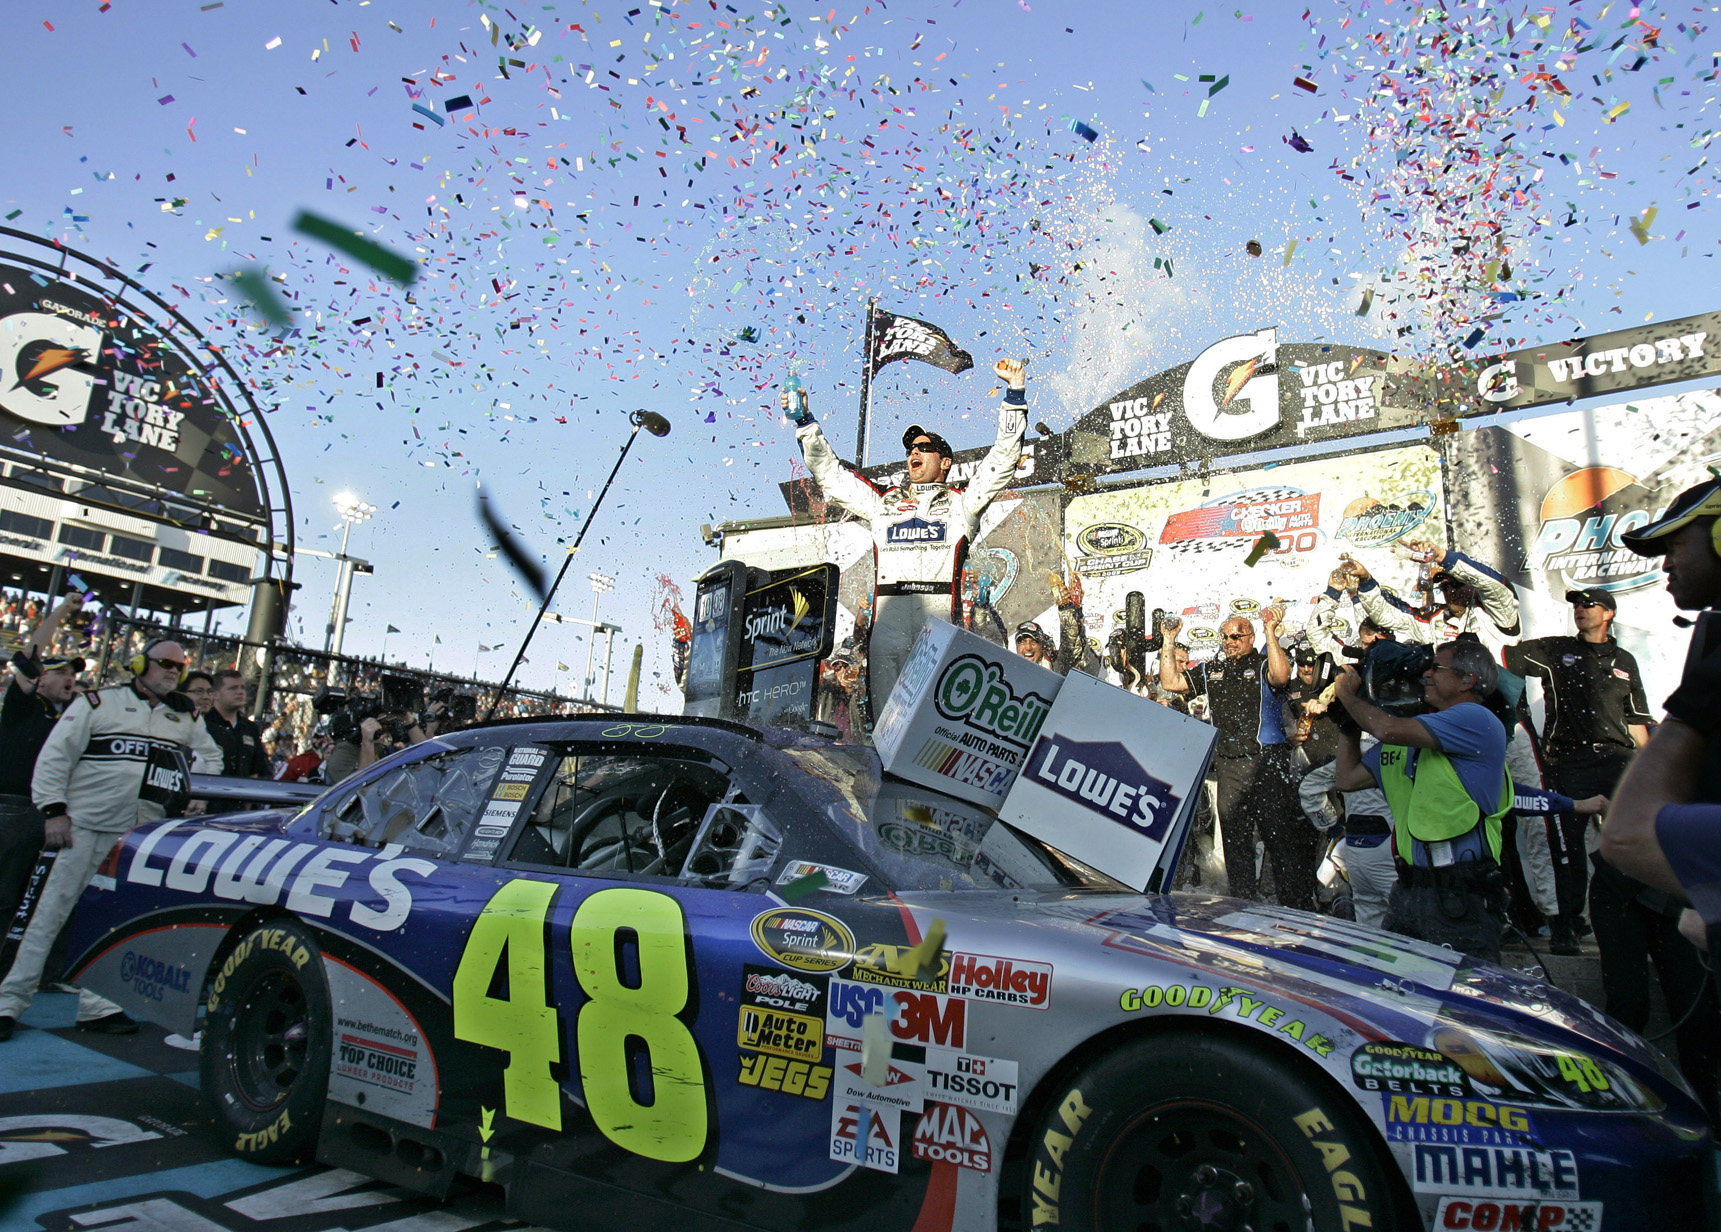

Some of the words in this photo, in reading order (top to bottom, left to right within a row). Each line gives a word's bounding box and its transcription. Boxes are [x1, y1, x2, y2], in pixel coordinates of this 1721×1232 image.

[1547, 332, 1707, 383] VICTORY
[112, 369, 162, 402] VIC
[1182, 326, 1280, 441] G
[1299, 361, 1345, 387] VIC
[1300, 377, 1375, 405] TORY
[107, 390, 185, 431] TORY
[1109, 397, 1149, 421] VIC
[1302, 393, 1375, 429] LANE
[100, 411, 181, 453] LANE
[1109, 413, 1172, 440] TORY
[1109, 431, 1172, 460] LANE
[1230, 500, 1302, 521] CHECKER
[1335, 509, 1425, 540] PHOENIX
[892, 526, 941, 540] LOWE'S
[1572, 558, 1659, 581] RACEWAY
[744, 603, 788, 645] Sprint
[940, 661, 1050, 743] O'Reill
[934, 726, 960, 741] Official
[959, 732, 987, 752] AUTO
[509, 754, 545, 767] GUARD
[146, 763, 183, 792] LOWE'S
[501, 771, 535, 782] Purolator
[1038, 743, 1161, 828] LOWE'S
[484, 810, 516, 818] SIEMENS
[126, 818, 438, 932] LOWE'S
[780, 919, 820, 933] NASCAR
[782, 932, 818, 948] Sprint
[137, 955, 191, 993] KOBALT
[207, 928, 310, 1014] GOODYEAR
[783, 954, 803, 962] CUP
[804, 957, 838, 967] SERIES
[133, 977, 165, 1002] TOOLS
[746, 974, 781, 996] Coors
[781, 985, 821, 1002] LIGHT
[852, 966, 911, 989] MECHANIX
[912, 980, 947, 993] WEAR
[951, 954, 1049, 1004] Holley
[755, 995, 809, 1012] POLE
[950, 985, 971, 995] HP
[974, 987, 1029, 1004] CARBS
[338, 1018, 418, 1047] www.bethematch.org
[452, 878, 707, 1163] 48
[762, 1014, 808, 1035] Auto
[889, 991, 966, 1049] 3M
[1119, 984, 1336, 1059] GOODYEAR
[757, 1029, 817, 1053] Meter
[761, 1044, 794, 1056] PERFORMANCE
[826, 1036, 863, 1050] SHEETR
[1364, 1045, 1443, 1061] GOODYEAR
[337, 1063, 368, 1079] LUMBER
[371, 1072, 415, 1091] PRODUCTS
[340, 1045, 365, 1065] TOP
[367, 1052, 417, 1080] CHOICE
[738, 1054, 833, 1100] JEGS
[1353, 1055, 1463, 1084] Gatorback
[1554, 1049, 1611, 1093] 48
[846, 1087, 865, 1098] Dow
[865, 1091, 911, 1108] Automotive
[926, 1070, 1016, 1102] TISSOT
[1364, 1078, 1465, 1097] BELTS
[979, 1101, 999, 1110] SINCE
[1388, 1095, 1530, 1133] MOOG
[235, 1108, 293, 1153] EAGLE
[835, 1104, 893, 1149] EA
[914, 1106, 989, 1154] MAC
[1396, 1126, 1469, 1143] CHASSIS
[1483, 1131, 1535, 1146] PAR
[833, 1139, 895, 1167] SPRTS
[914, 1141, 989, 1170] TOOLS
[1032, 1089, 1093, 1226] YEAR
[1414, 1144, 1577, 1192] MAHLE
[1443, 1201, 1565, 1232] COMP
